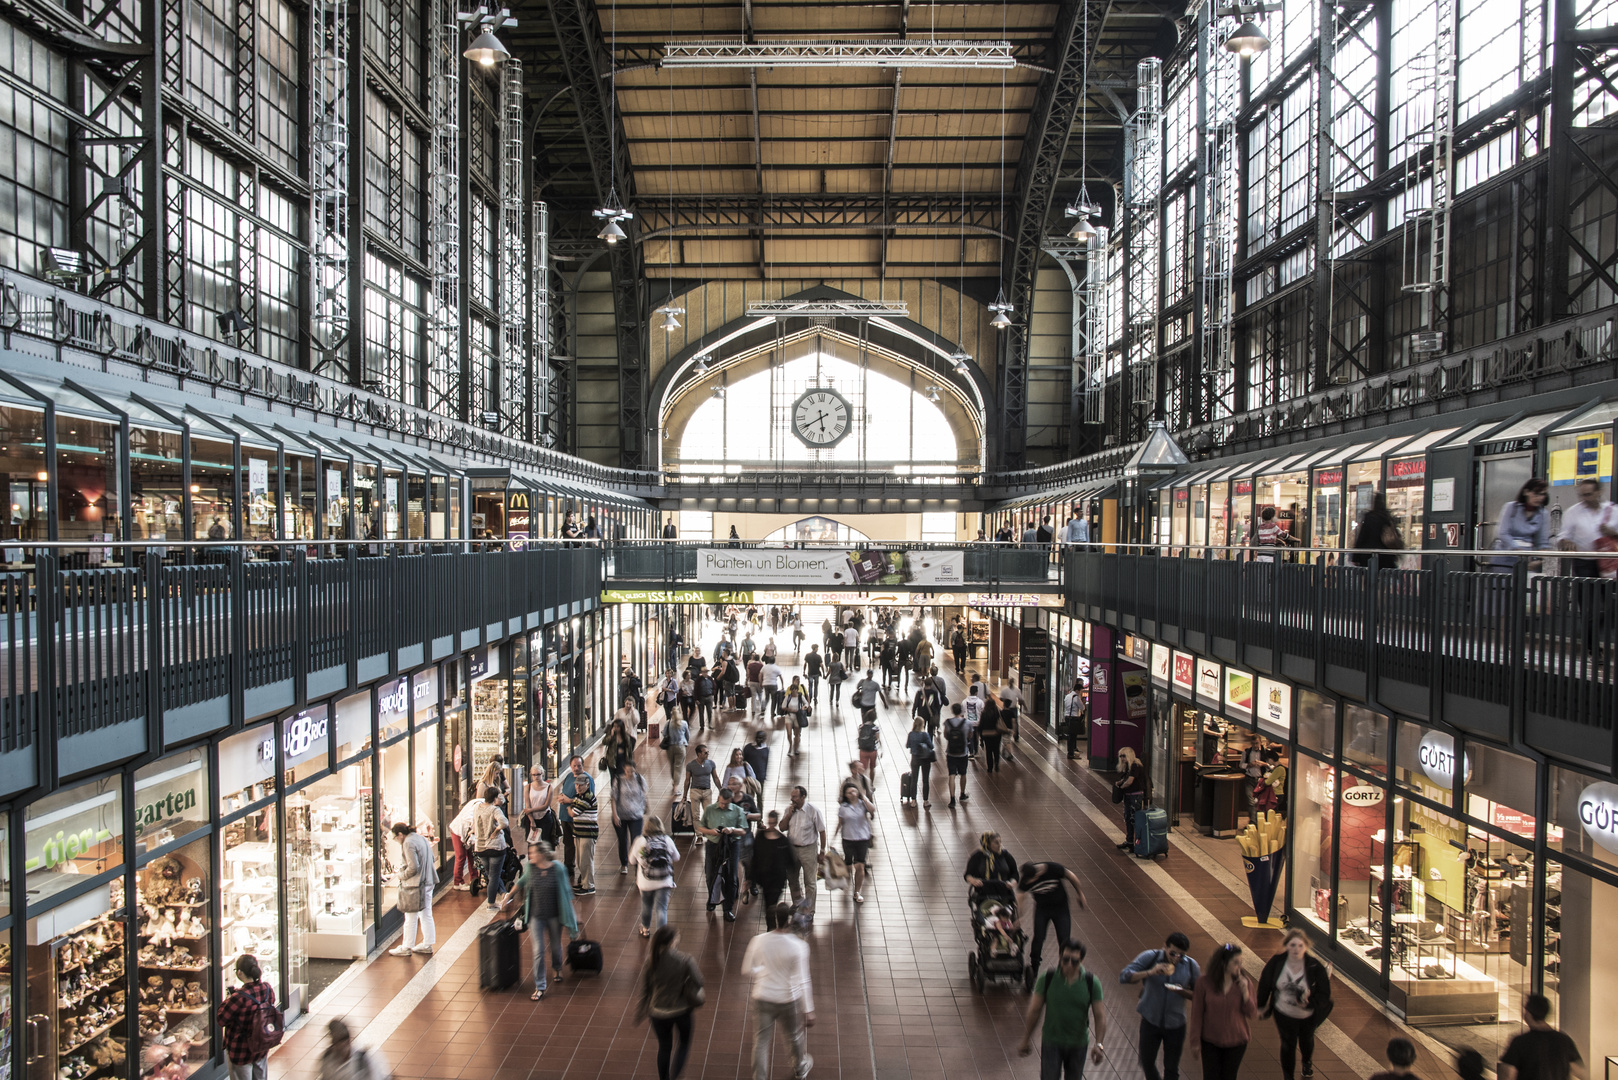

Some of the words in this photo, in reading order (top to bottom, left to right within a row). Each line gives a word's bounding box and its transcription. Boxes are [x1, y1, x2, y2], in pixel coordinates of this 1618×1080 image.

[828, 396, 834, 404] I
[1576, 437, 1599, 476] E
[706, 554, 752, 569] Planten
[756, 559, 771, 569] un
[776, 555, 828, 570] Blomen.
[685, 592, 704, 602] DA!
[263, 732, 291, 761] BIJU
[1420, 745, 1455, 774] GÖRT
[136, 788, 196, 838] garten
